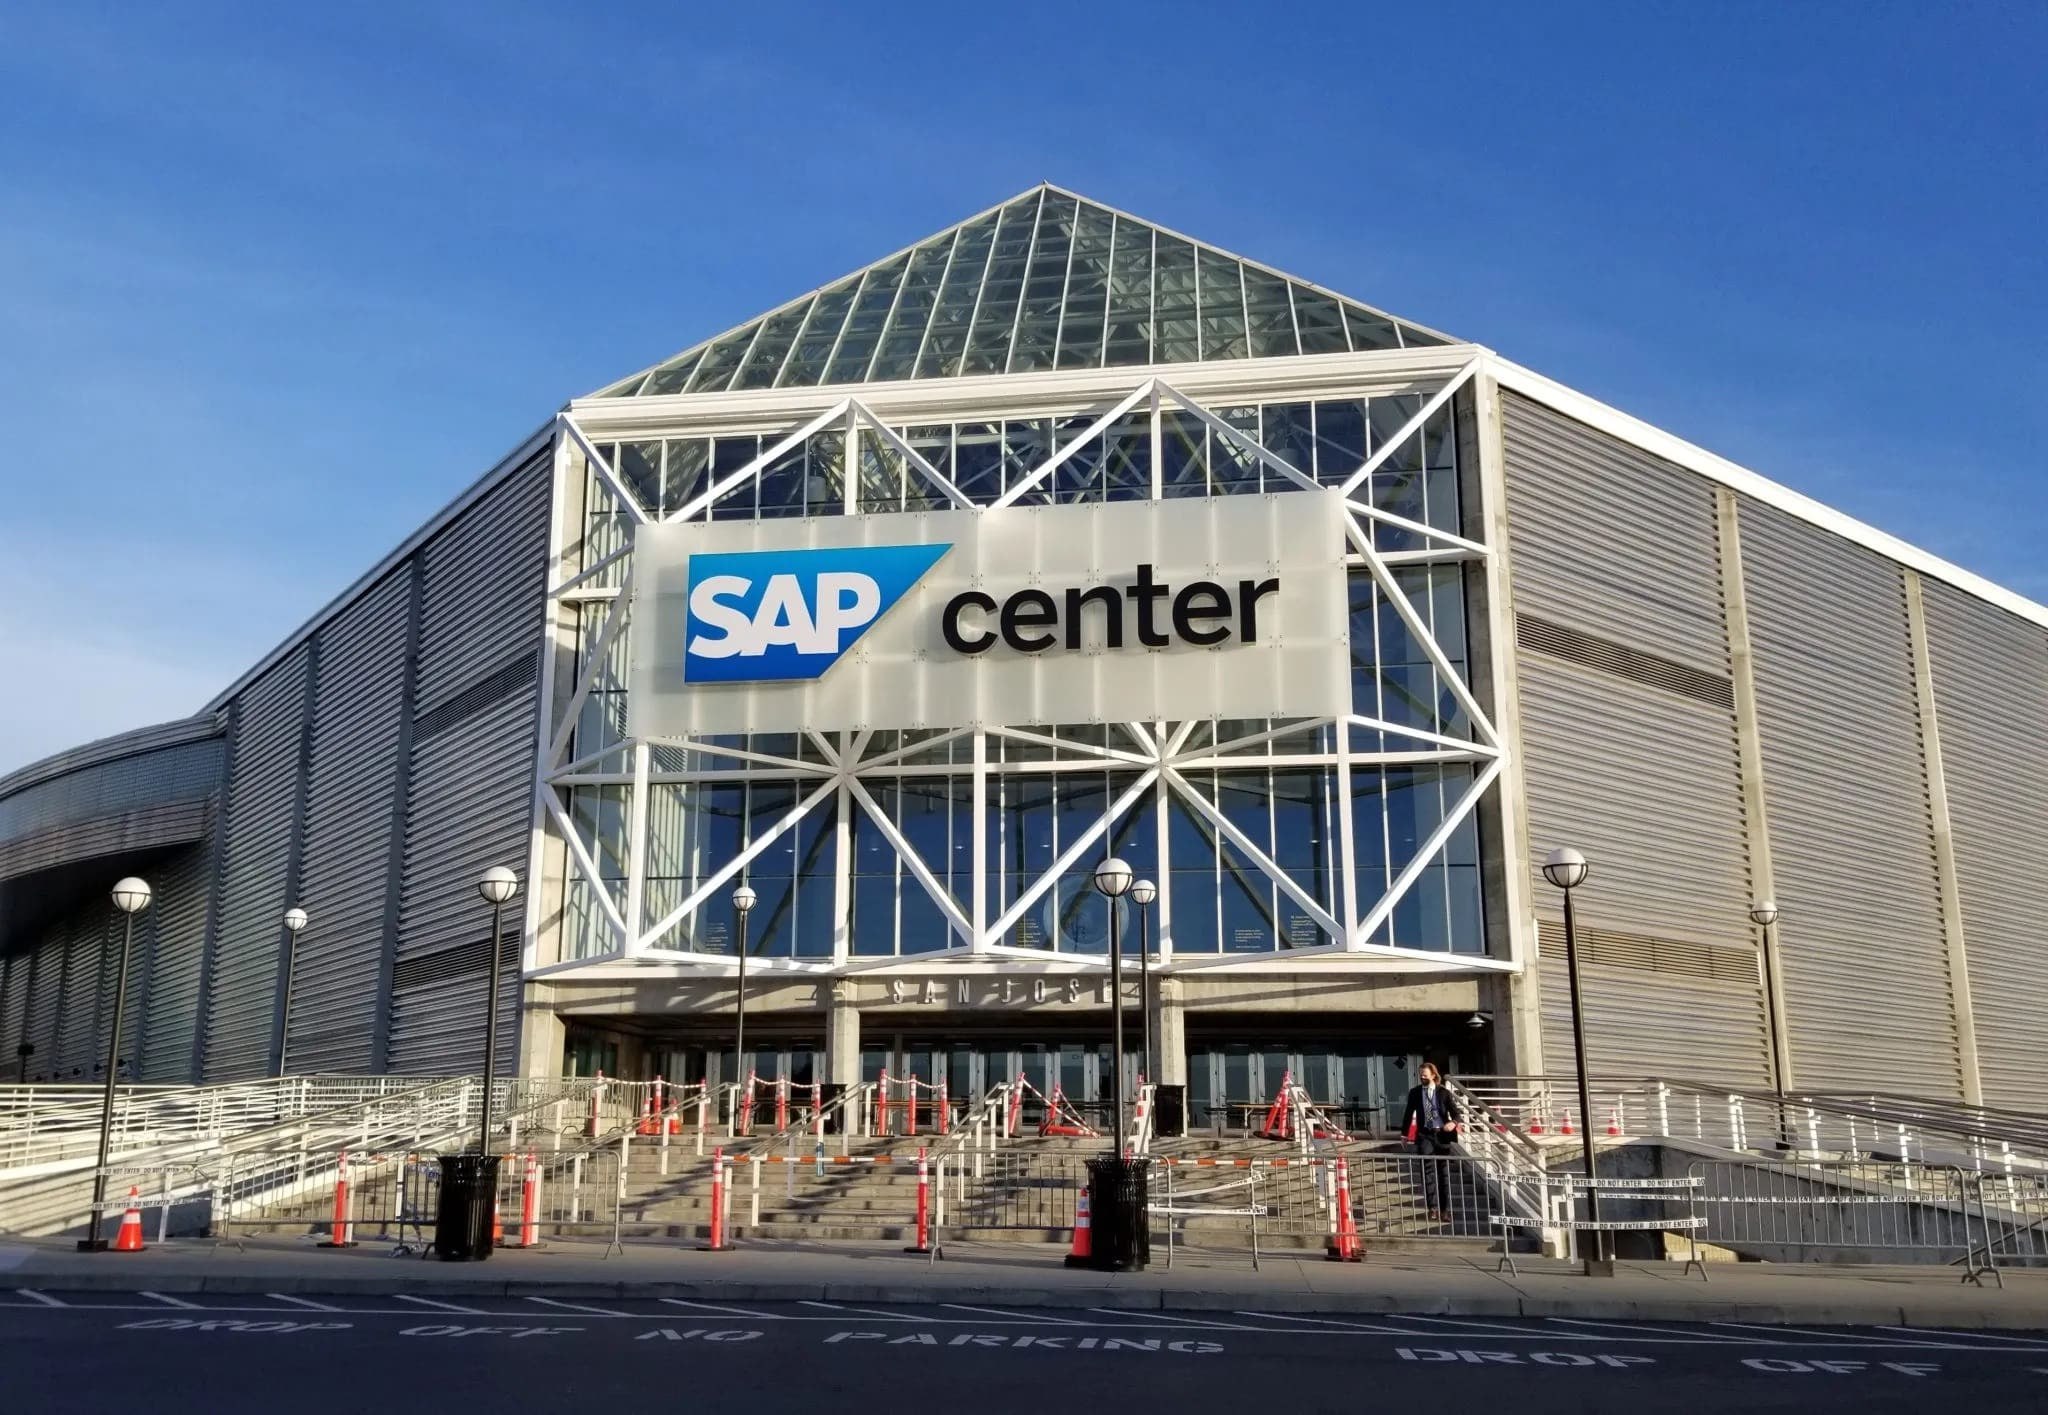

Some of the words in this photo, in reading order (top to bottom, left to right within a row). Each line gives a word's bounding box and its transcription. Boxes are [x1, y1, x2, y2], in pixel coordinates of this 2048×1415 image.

[688, 572, 881, 659] SAP
[942, 564, 1280, 655] center
[893, 979, 970, 1004] SAN
[1001, 979, 1114, 1004] JOSE
[114, 1318, 354, 1333] DROP
[399, 1324, 586, 1338] OFF
[633, 1328, 765, 1342] NO
[821, 1331, 1225, 1354] PARKING
[1394, 1347, 1657, 1368] DROP
[1740, 1358, 1943, 1377] OFF
